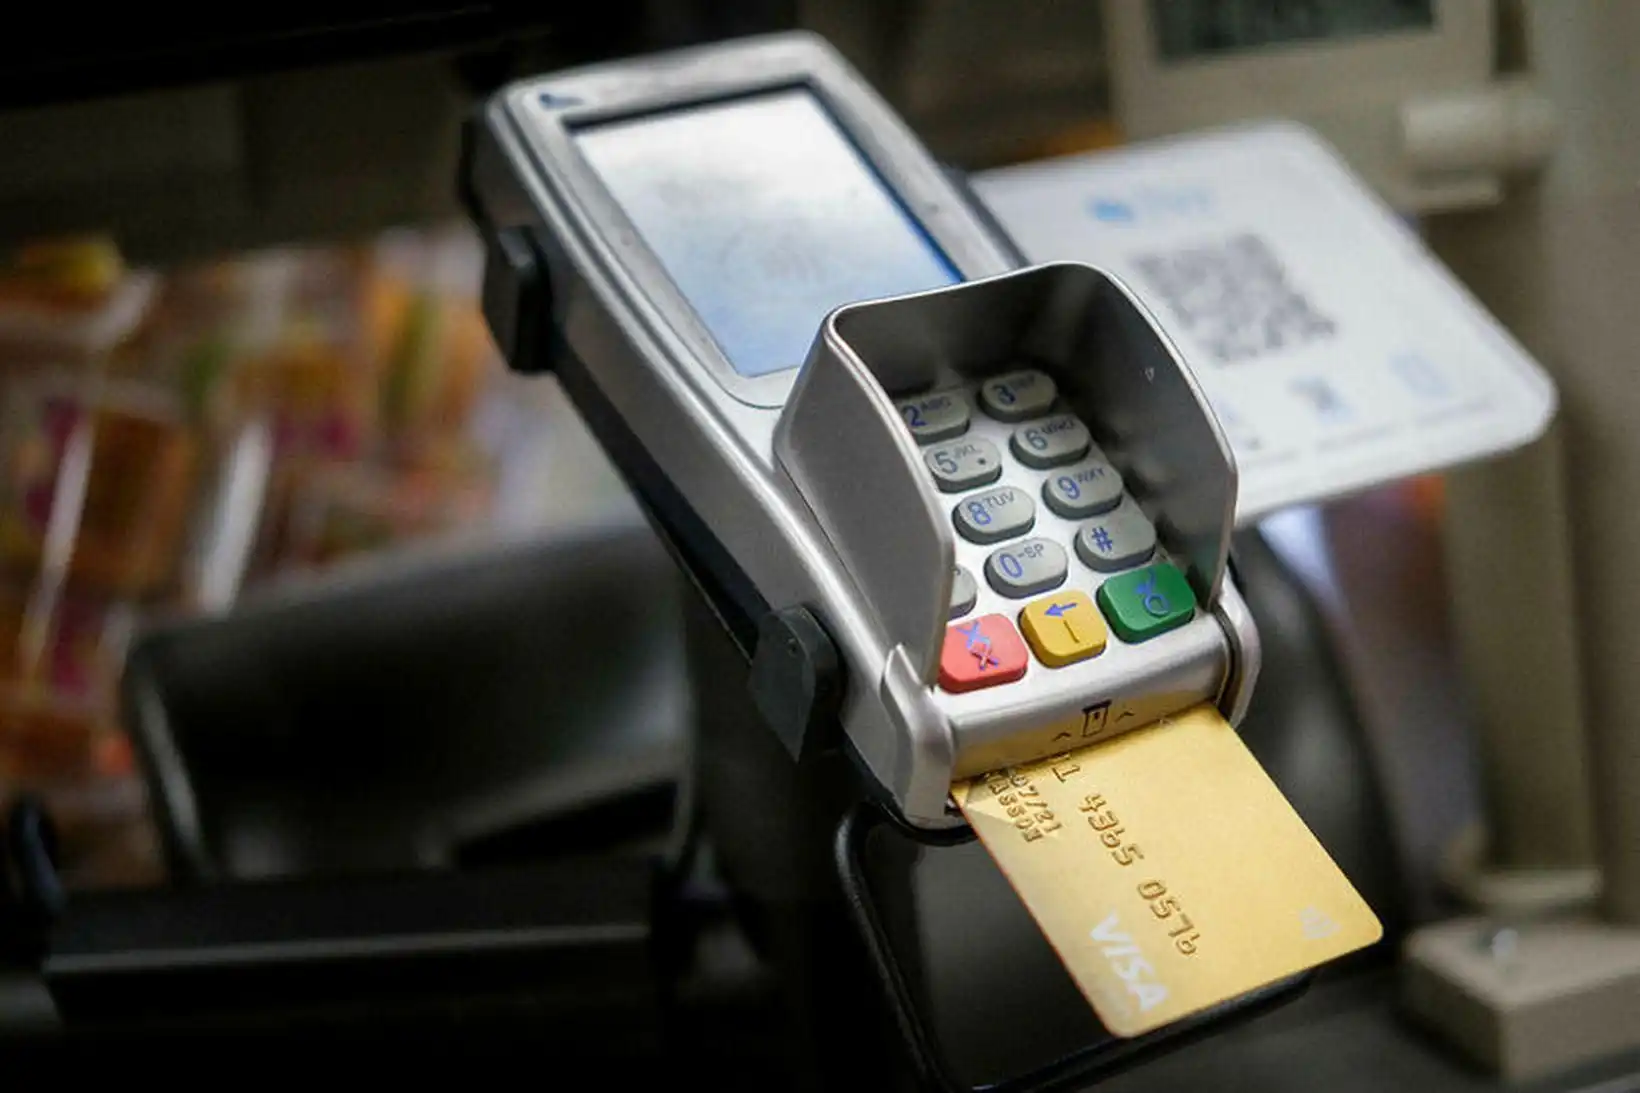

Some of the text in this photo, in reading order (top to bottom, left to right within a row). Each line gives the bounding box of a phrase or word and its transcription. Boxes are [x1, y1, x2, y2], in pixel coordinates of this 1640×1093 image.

[992, 383, 1016, 405] 3
[902, 405, 927, 428] 2
[1025, 428, 1049, 451] 6
[934, 451, 958, 475] 5
[1057, 475, 1081, 500] 9
[967, 490, 1015, 526] 8 TUV
[999, 552, 1024, 579] 0
[1089, 908, 1171, 1015] VISA
